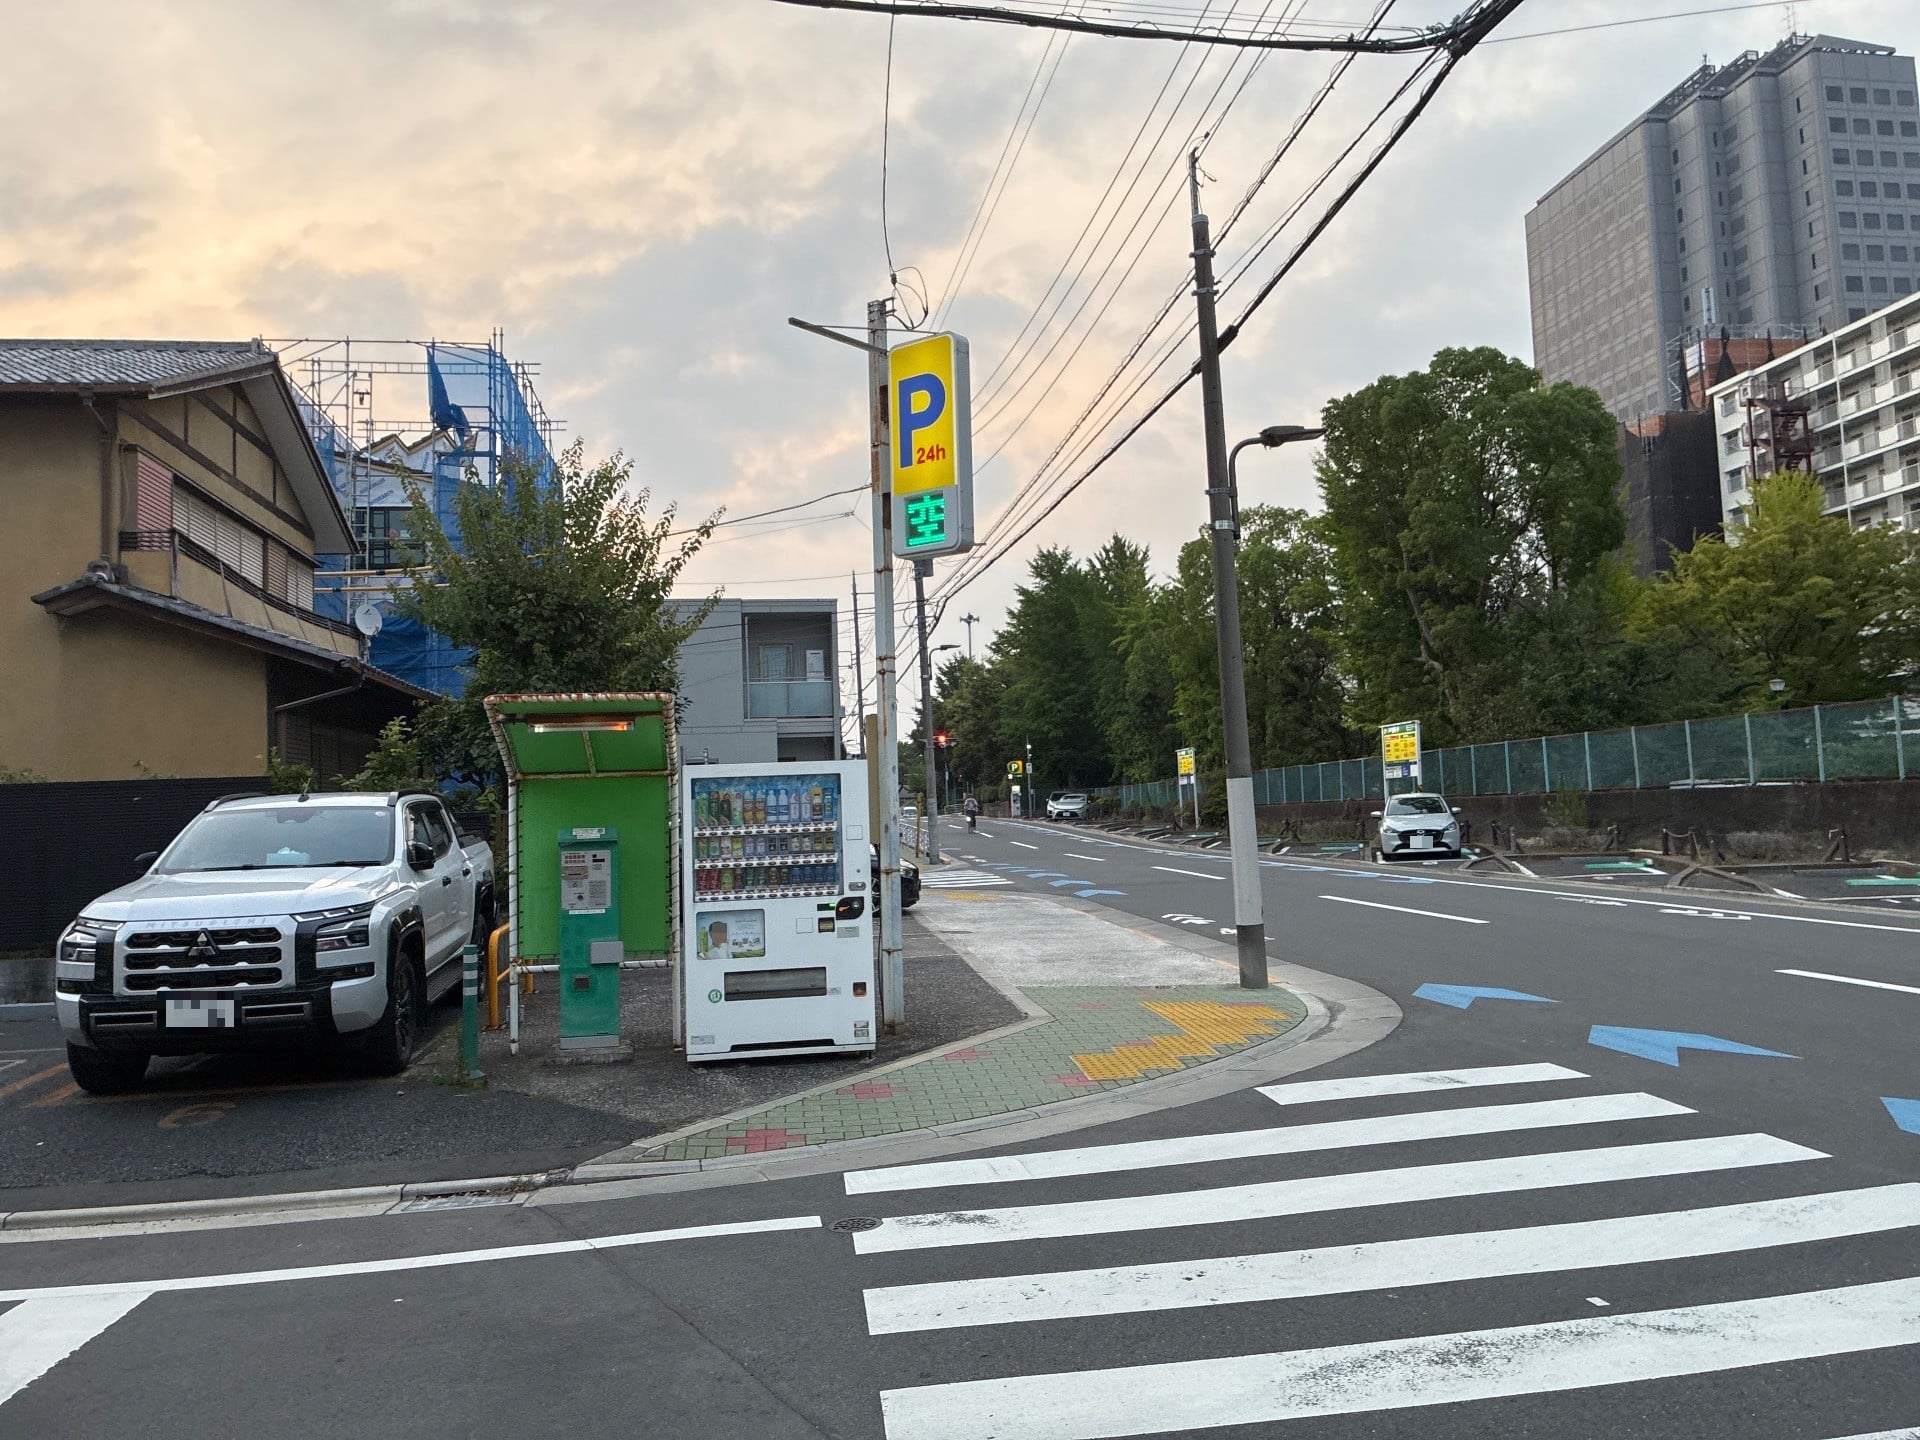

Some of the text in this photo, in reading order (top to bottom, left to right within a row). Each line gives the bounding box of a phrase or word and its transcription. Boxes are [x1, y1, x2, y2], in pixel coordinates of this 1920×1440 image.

[898, 373, 946, 469] P
[916, 444, 946, 464] 24h
[907, 495, 946, 547] 空
